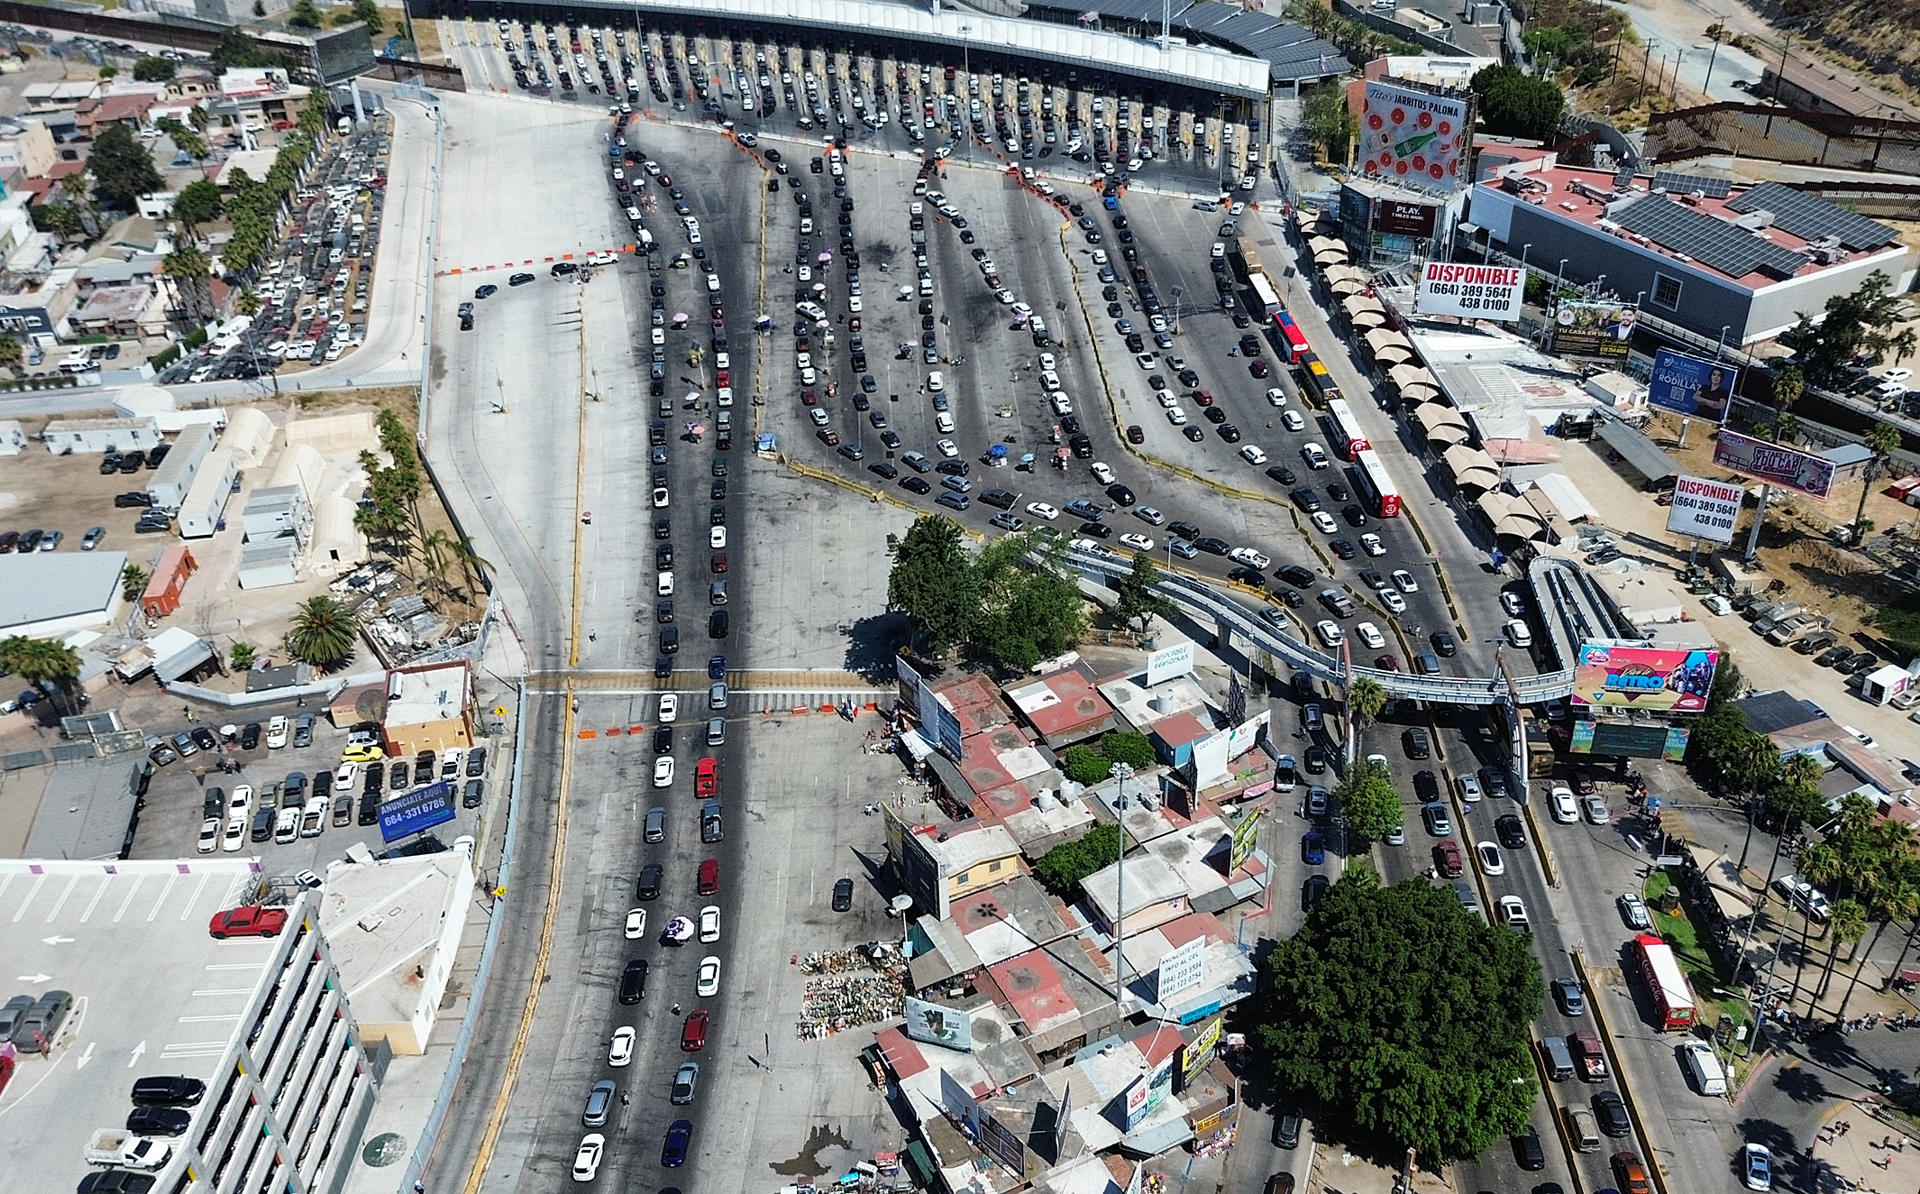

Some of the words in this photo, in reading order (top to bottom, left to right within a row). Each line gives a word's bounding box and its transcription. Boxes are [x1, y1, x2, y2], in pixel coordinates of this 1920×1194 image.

[1369, 89, 1392, 102] Tito's
[1394, 94, 1426, 110] JARRITOS
[1429, 102, 1458, 118] PALOMA
[1396, 206, 1420, 215] PLAY.
[1426, 264, 1519, 286] DISPONIBLE
[1430, 282, 1459, 296] (664)
[1461, 285, 1483, 297] 389
[1485, 286, 1512, 299] 5641
[1459, 298, 1480, 309] 438
[1483, 299, 1509, 311] 0100
[1659, 374, 1702, 391] RODILLA?
[1678, 479, 1740, 502] DISPONIBLE
[1674, 496, 1697, 509] (664)
[1700, 500, 1715, 512] 389
[1718, 503, 1737, 517] 5641
[1694, 513, 1710, 524] 438
[1712, 516, 1733, 529] 0100
[1605, 673, 1664, 688] RETRO
[381, 792, 423, 814] ANUNCIATE
[385, 806, 421, 826] 664-331
[422, 797, 445, 813] 6786
[1165, 962, 1179, 972] INFO
